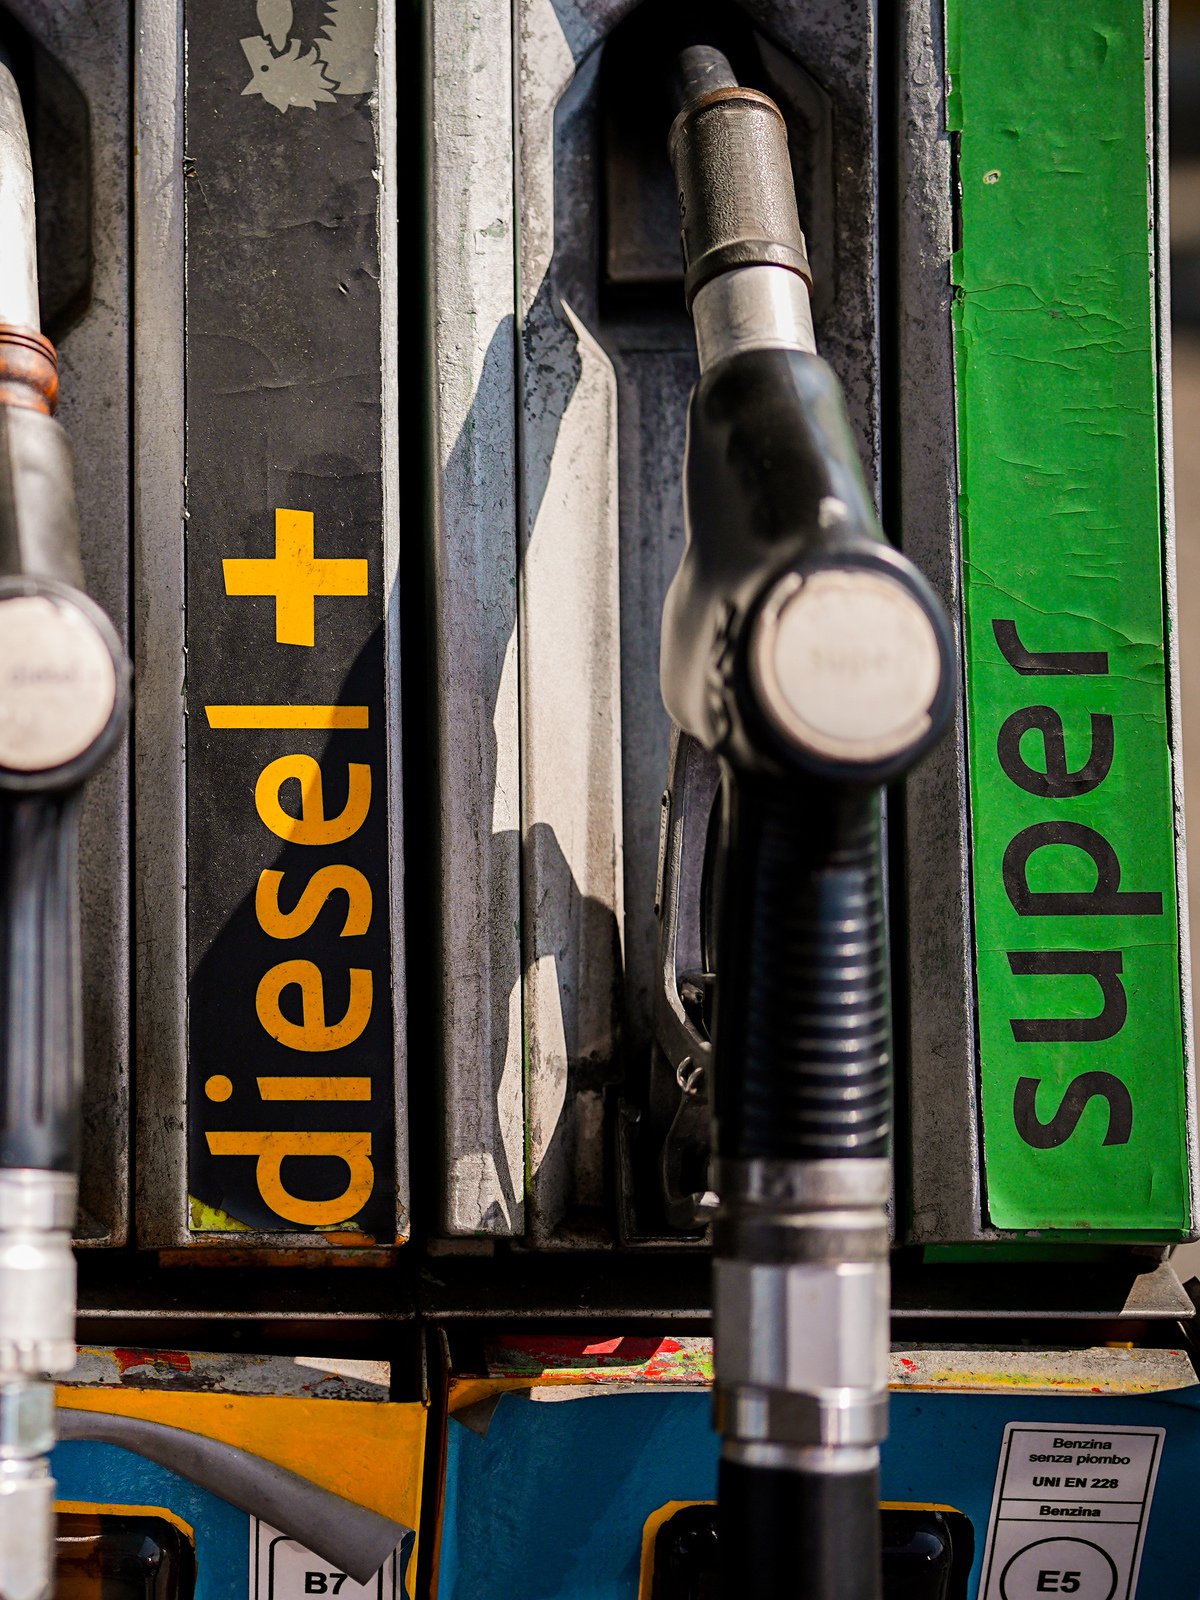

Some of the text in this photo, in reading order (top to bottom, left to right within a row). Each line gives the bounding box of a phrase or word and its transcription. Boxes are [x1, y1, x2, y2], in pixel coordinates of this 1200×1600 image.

[991, 618, 1164, 1150] super
[1053, 1438, 1112, 1450] Benzina
[1029, 1453, 1131, 1466] senza piombo
[1032, 1477, 1119, 1489] UNI EN 228
[1039, 1505, 1101, 1517] Benzina
[304, 1571, 348, 1595] B7
[1036, 1570, 1081, 1593] E5
